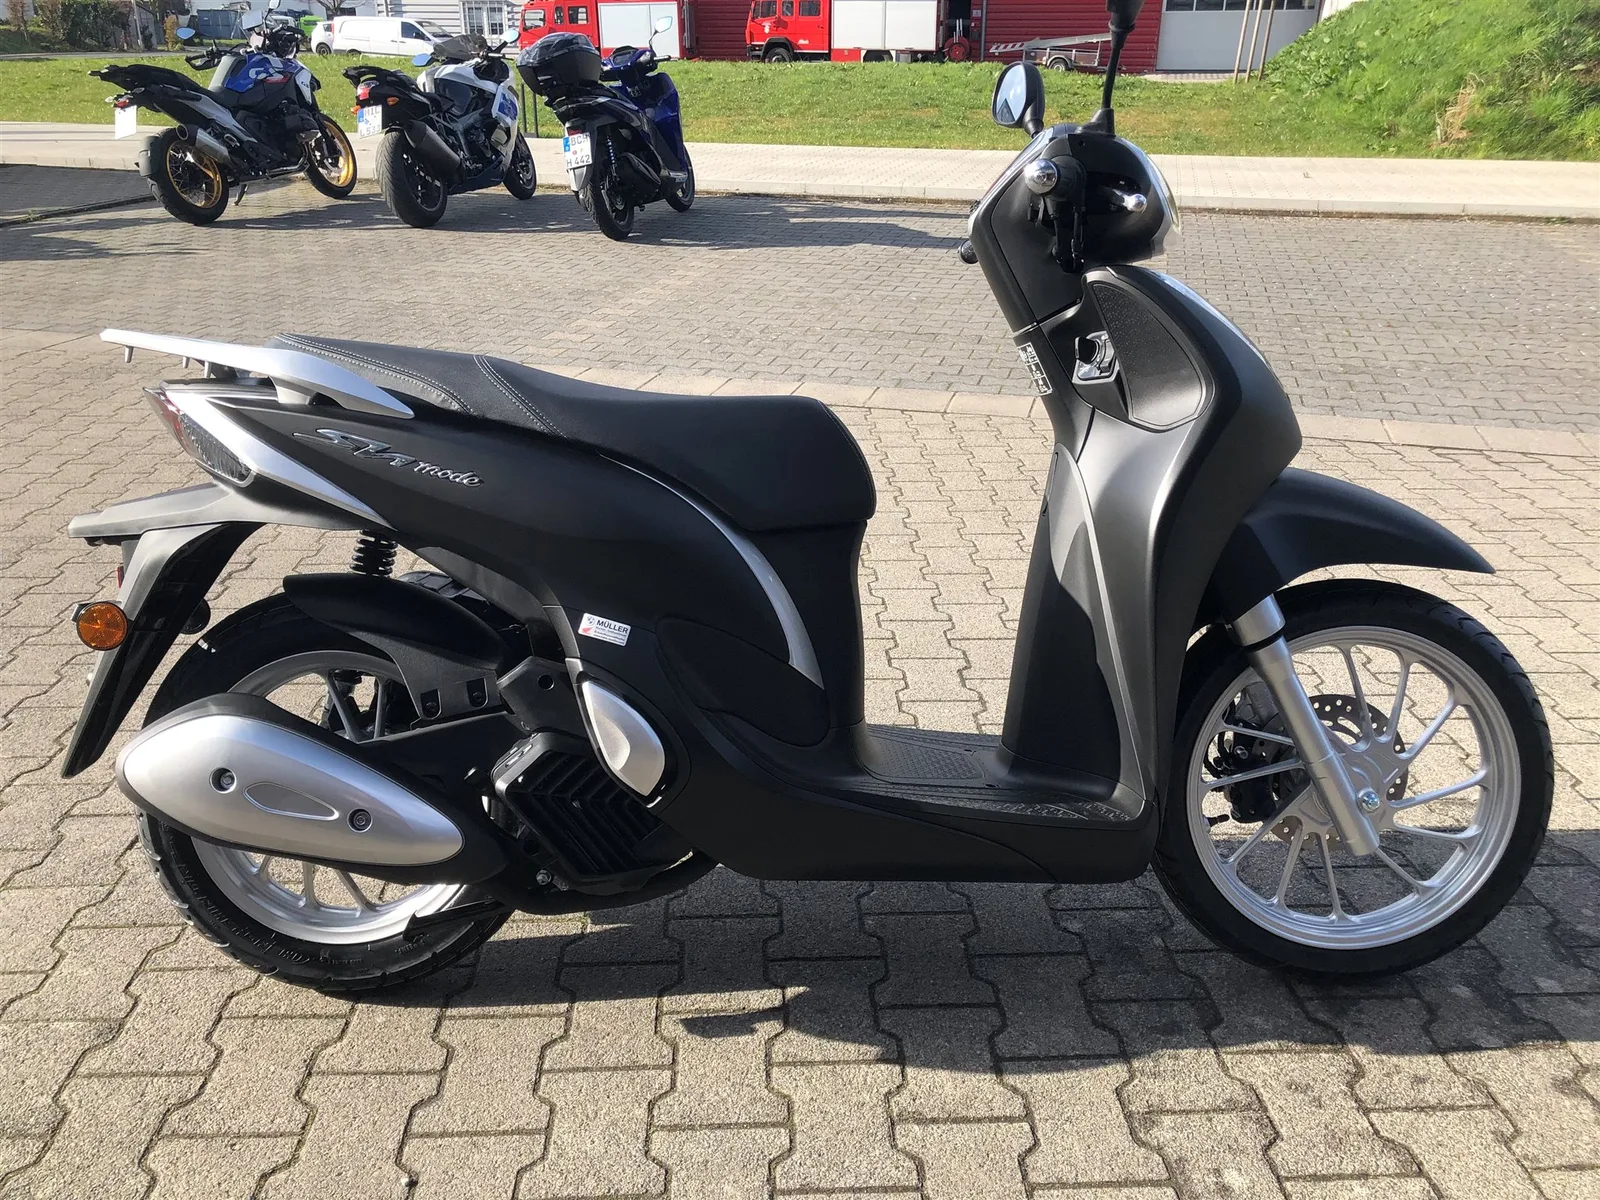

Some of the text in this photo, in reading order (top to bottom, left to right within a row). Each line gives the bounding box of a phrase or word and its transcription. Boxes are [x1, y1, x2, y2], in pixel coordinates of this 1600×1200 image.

[574, 155, 590, 165] 442
[413, 460, 484, 488] mode
[596, 619, 629, 634] MÜLLER
